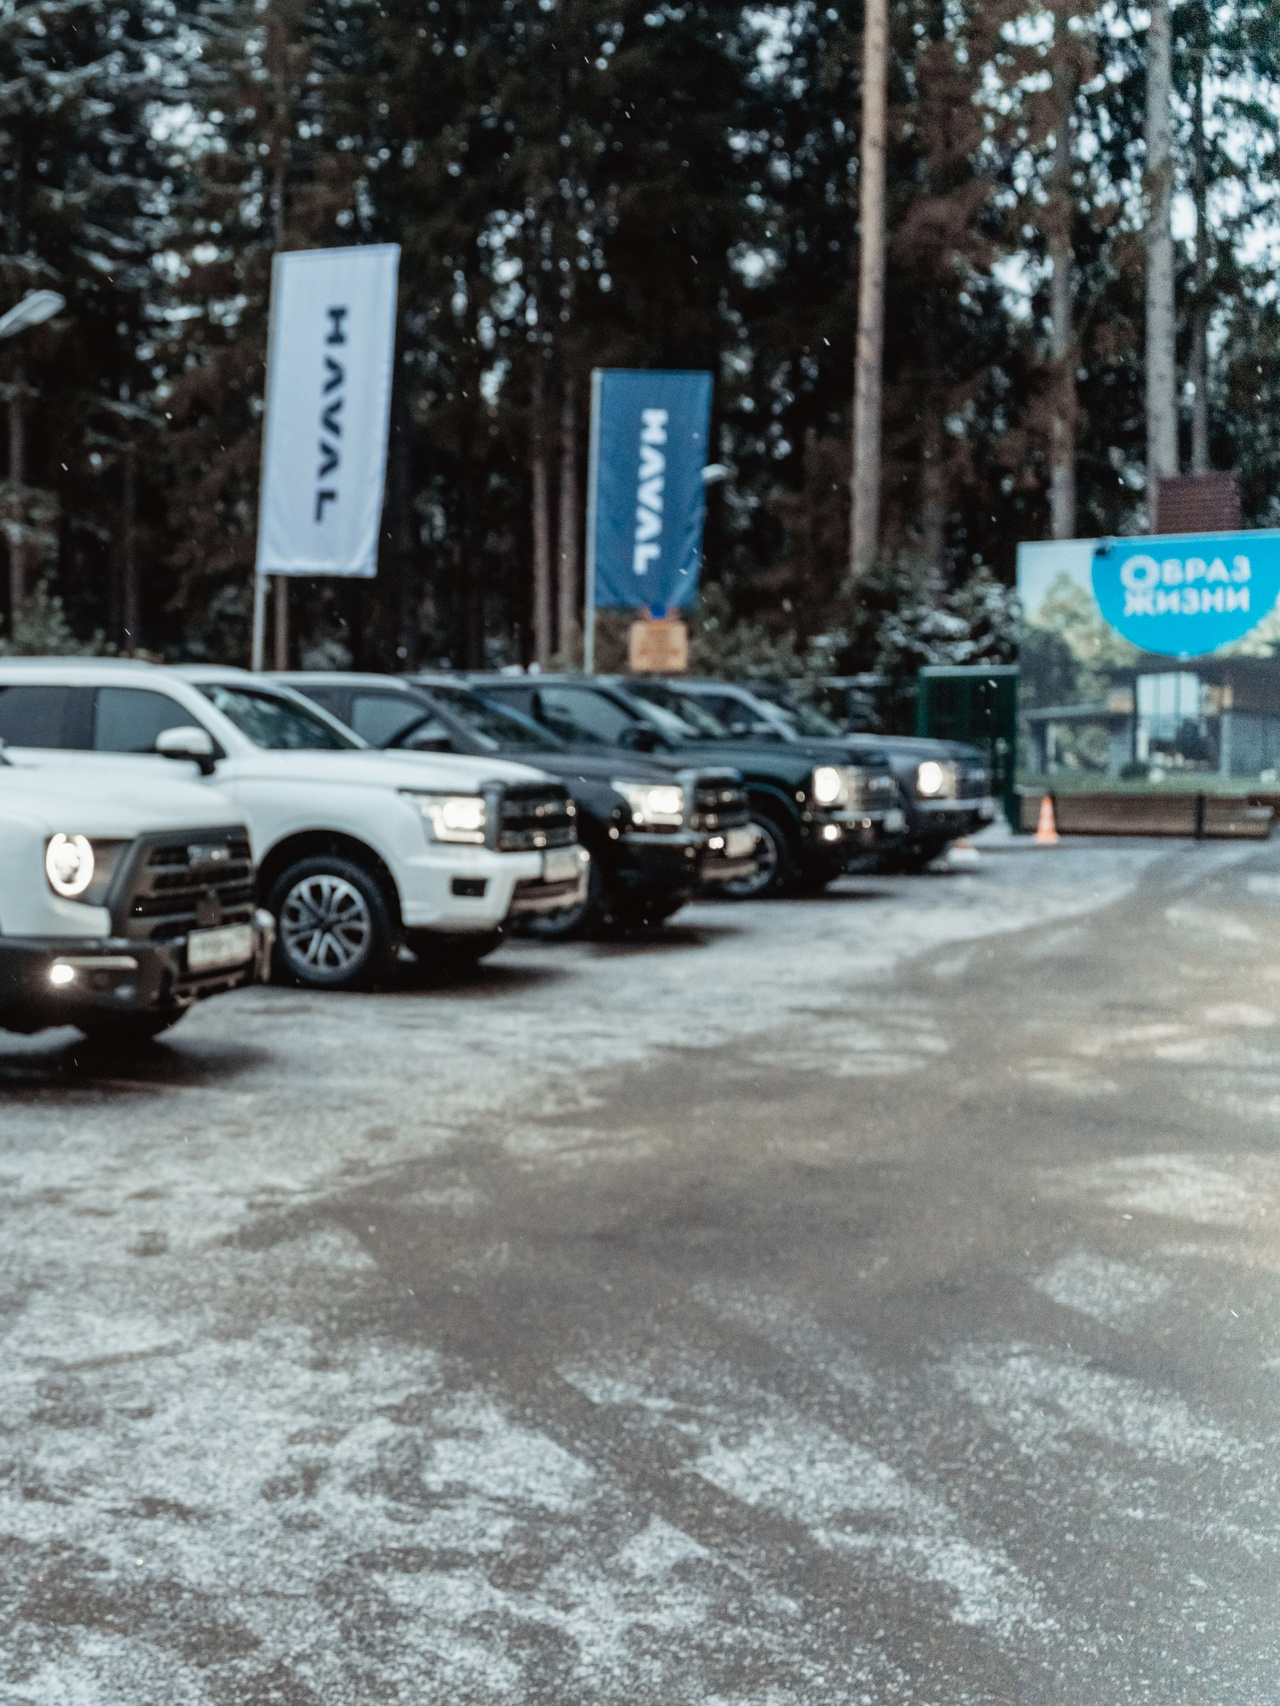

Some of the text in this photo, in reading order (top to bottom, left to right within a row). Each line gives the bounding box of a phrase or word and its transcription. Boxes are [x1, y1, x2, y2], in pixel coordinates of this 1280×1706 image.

[314, 305, 347, 523] HAVAL
[633, 408, 669, 575] HAVAL
[1121, 554, 1251, 589] ОБРАЗ
[1123, 586, 1250, 617] ЖИЗНИ
